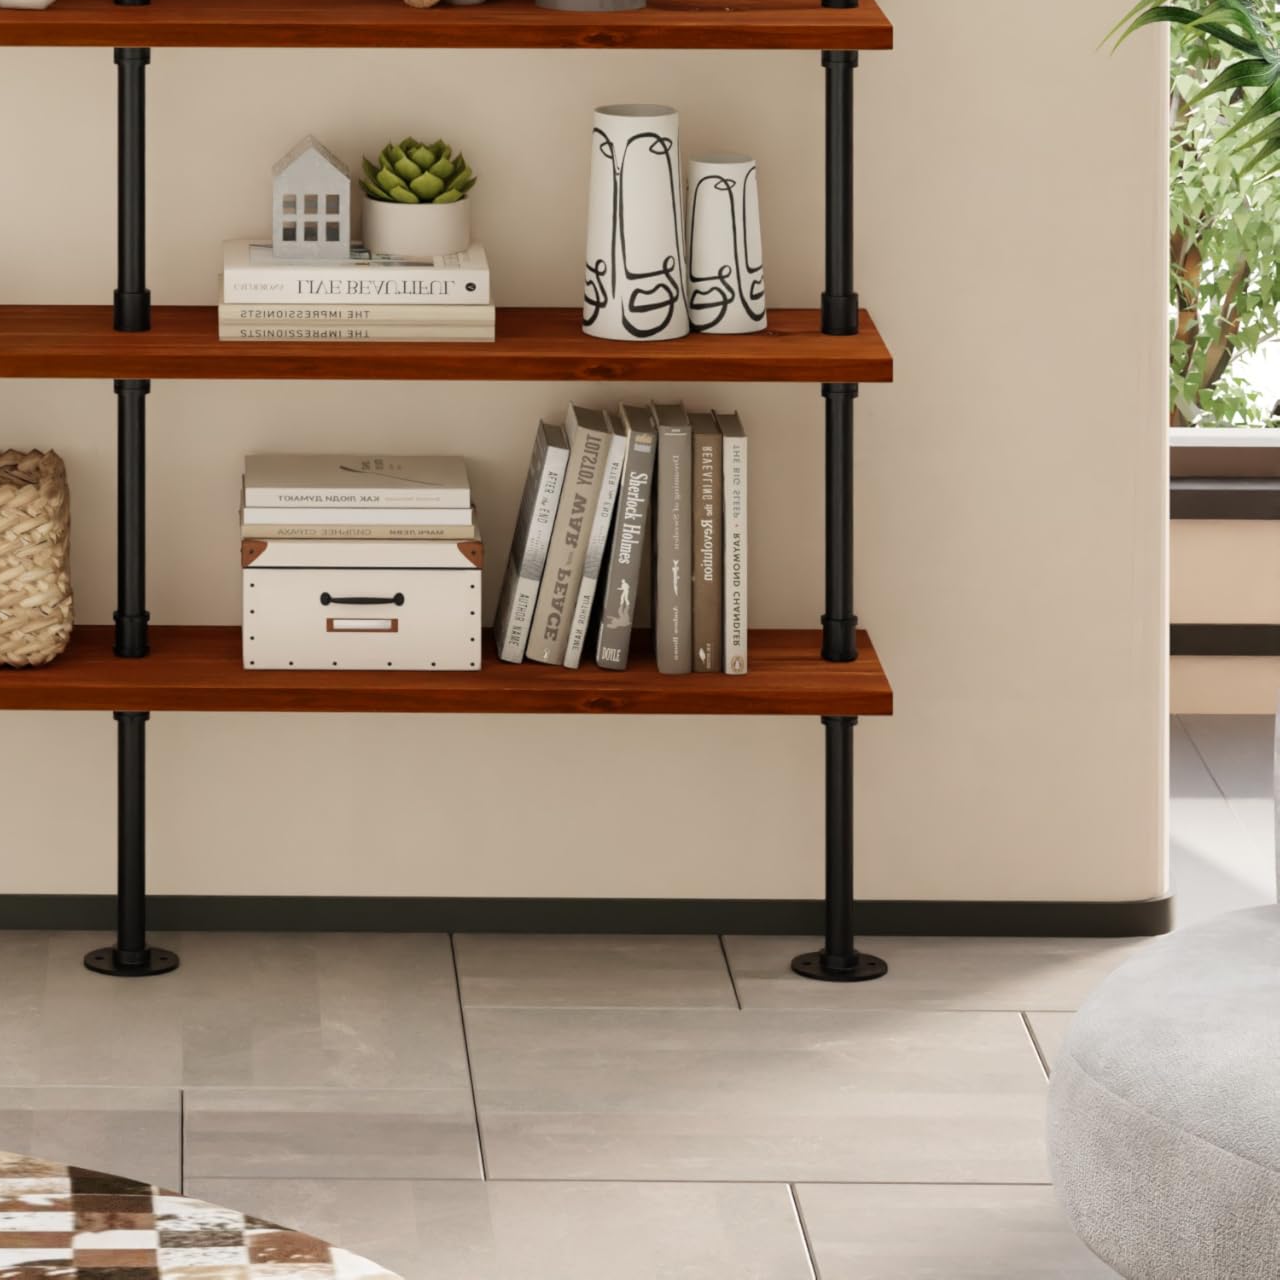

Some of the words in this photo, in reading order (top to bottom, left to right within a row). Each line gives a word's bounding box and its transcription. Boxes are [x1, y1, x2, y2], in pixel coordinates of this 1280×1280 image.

[240, 329, 342, 338] IMPRESSIONISTS
[348, 329, 370, 338] THE
[546, 471, 558, 494] AFTER
[626, 472, 648, 522] Sherlock
[537, 507, 550, 524] END
[618, 523, 641, 565] Holmes
[514, 593, 530, 622] AUTHOR
[508, 626, 522, 647] NAME
[602, 649, 621, 662] DOYLE
